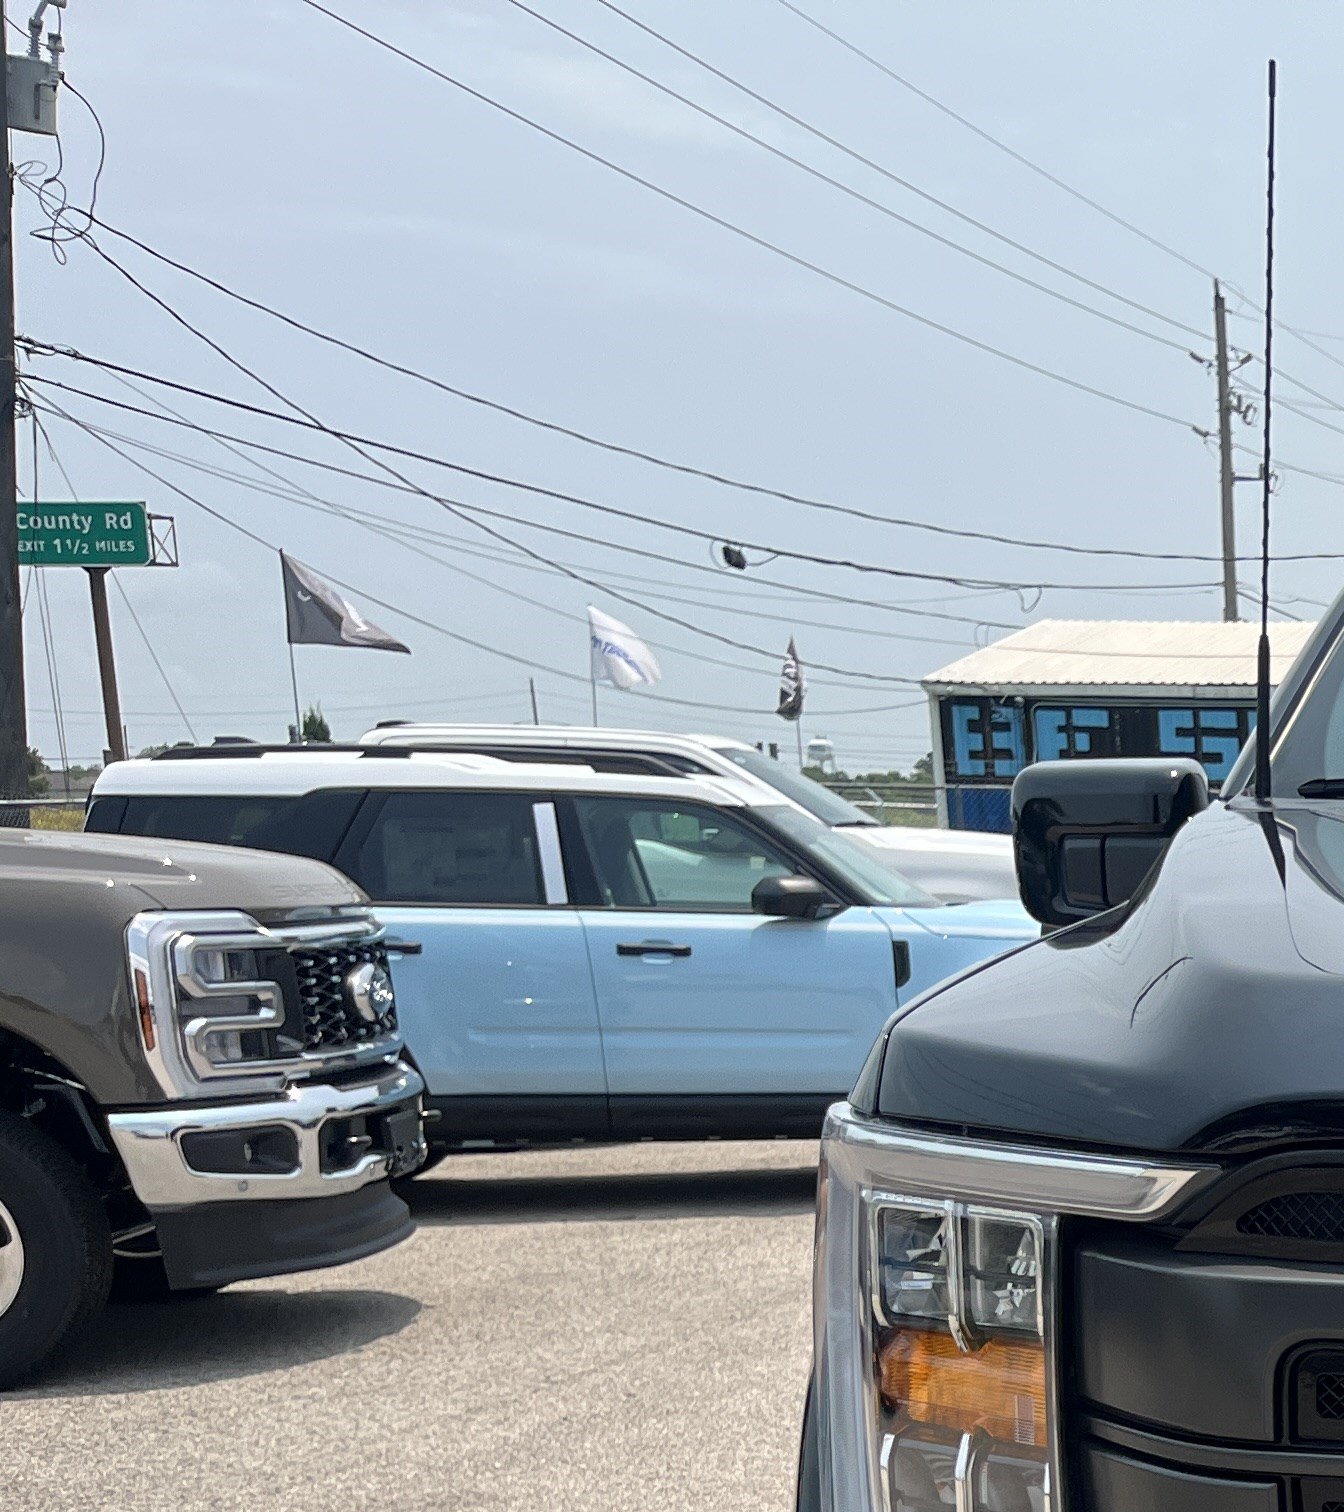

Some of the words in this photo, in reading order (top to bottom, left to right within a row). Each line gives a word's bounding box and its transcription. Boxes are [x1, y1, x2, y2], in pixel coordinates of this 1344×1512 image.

[16, 512, 92, 534] County
[105, 512, 133, 530] Rd
[18, 540, 45, 552] EXIT
[95, 540, 135, 552] MILES
